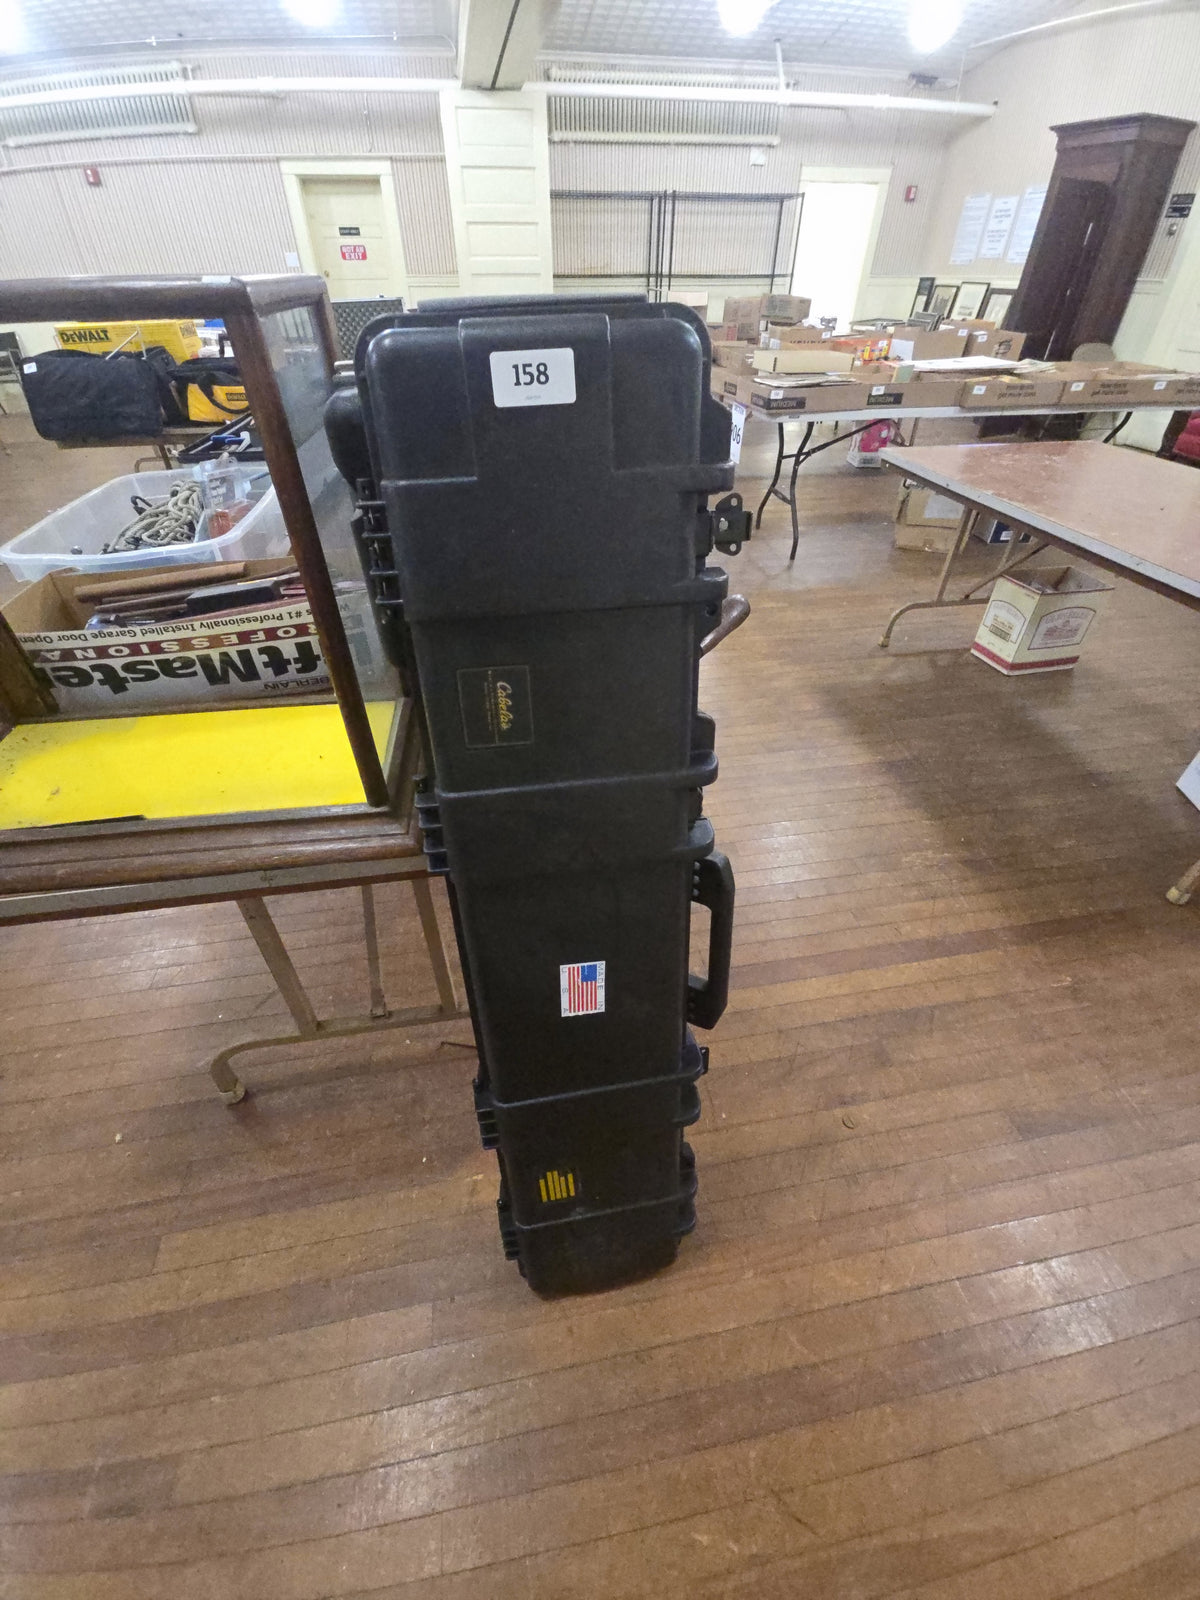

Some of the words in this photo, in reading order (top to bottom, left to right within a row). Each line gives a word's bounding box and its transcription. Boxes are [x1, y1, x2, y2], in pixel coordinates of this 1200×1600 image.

[342, 245, 353, 253] NOT
[355, 245, 364, 253] AN
[345, 252, 362, 260] EXIT
[511, 362, 550, 386] 158
[287, 611, 303, 620] #1
[200, 614, 284, 632] Professionally
[91, 630, 137, 639] Garage
[140, 624, 197, 638] Installed
[19, 635, 54, 644] Open
[41, 624, 318, 661] ROFESSIONA
[57, 634, 89, 642] Door
[263, 676, 330, 690] BERLAIN
[497, 682, 513, 730] Cabela's
[597, 1001, 604, 1011] IN
